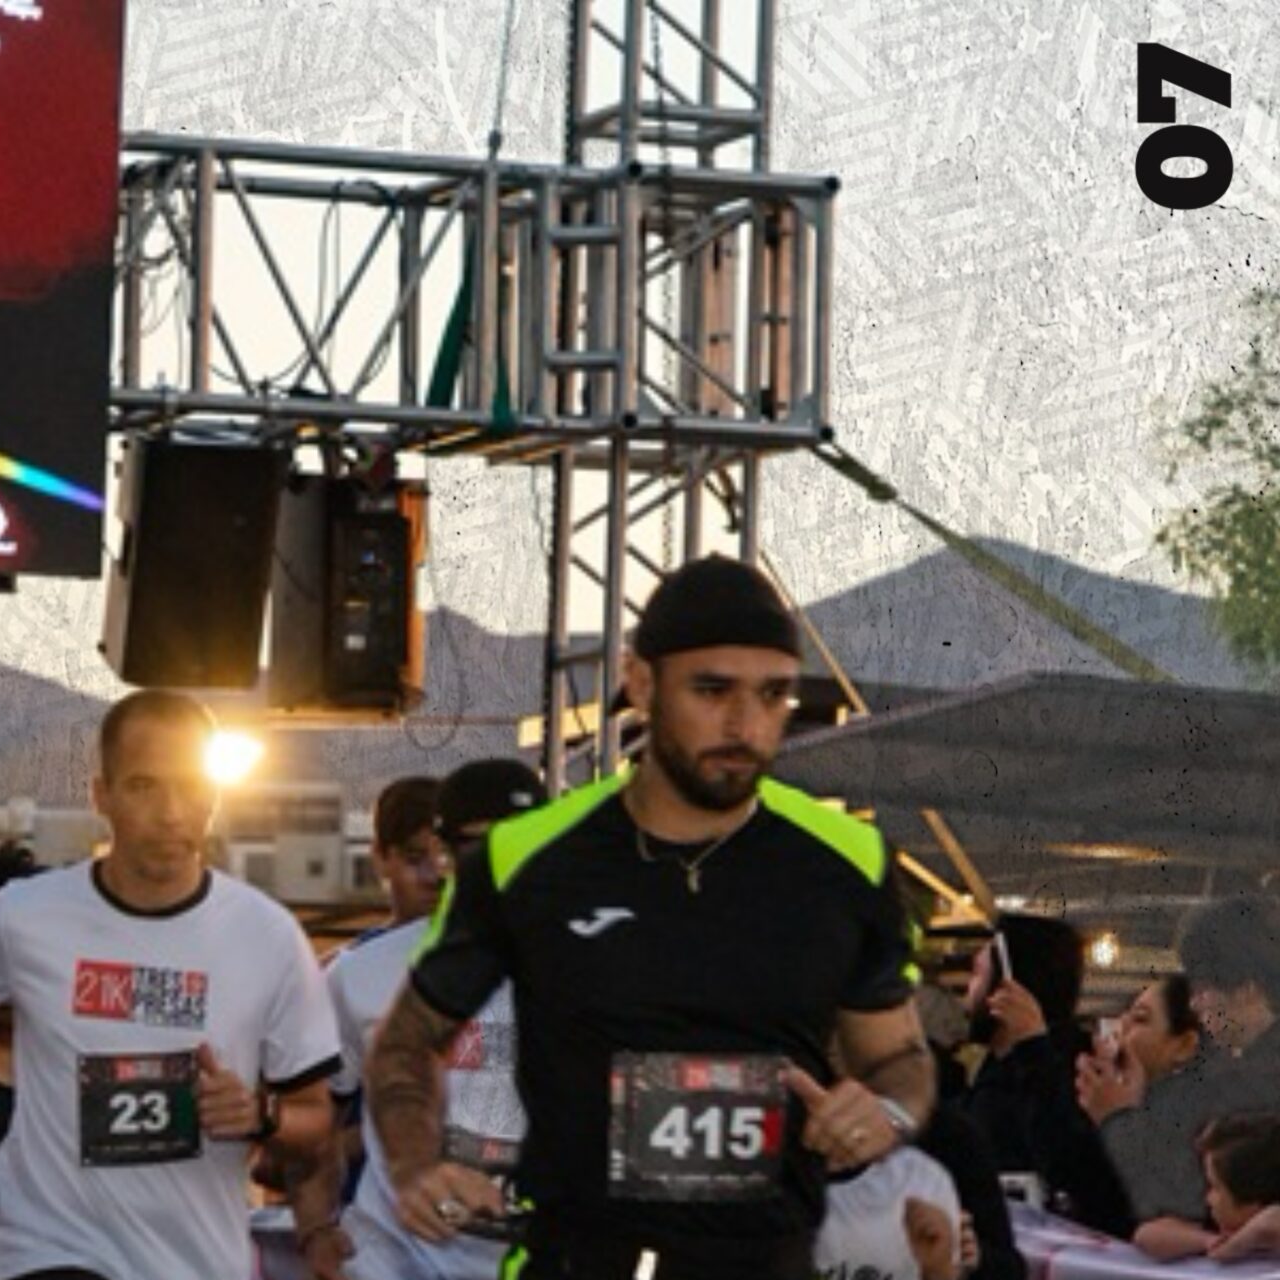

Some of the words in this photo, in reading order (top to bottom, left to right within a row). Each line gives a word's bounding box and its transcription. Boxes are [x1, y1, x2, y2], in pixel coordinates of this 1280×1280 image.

[75, 968, 133, 1012] 21K
[108, 1091, 171, 1135] 23
[649, 1105, 766, 1161] 415
